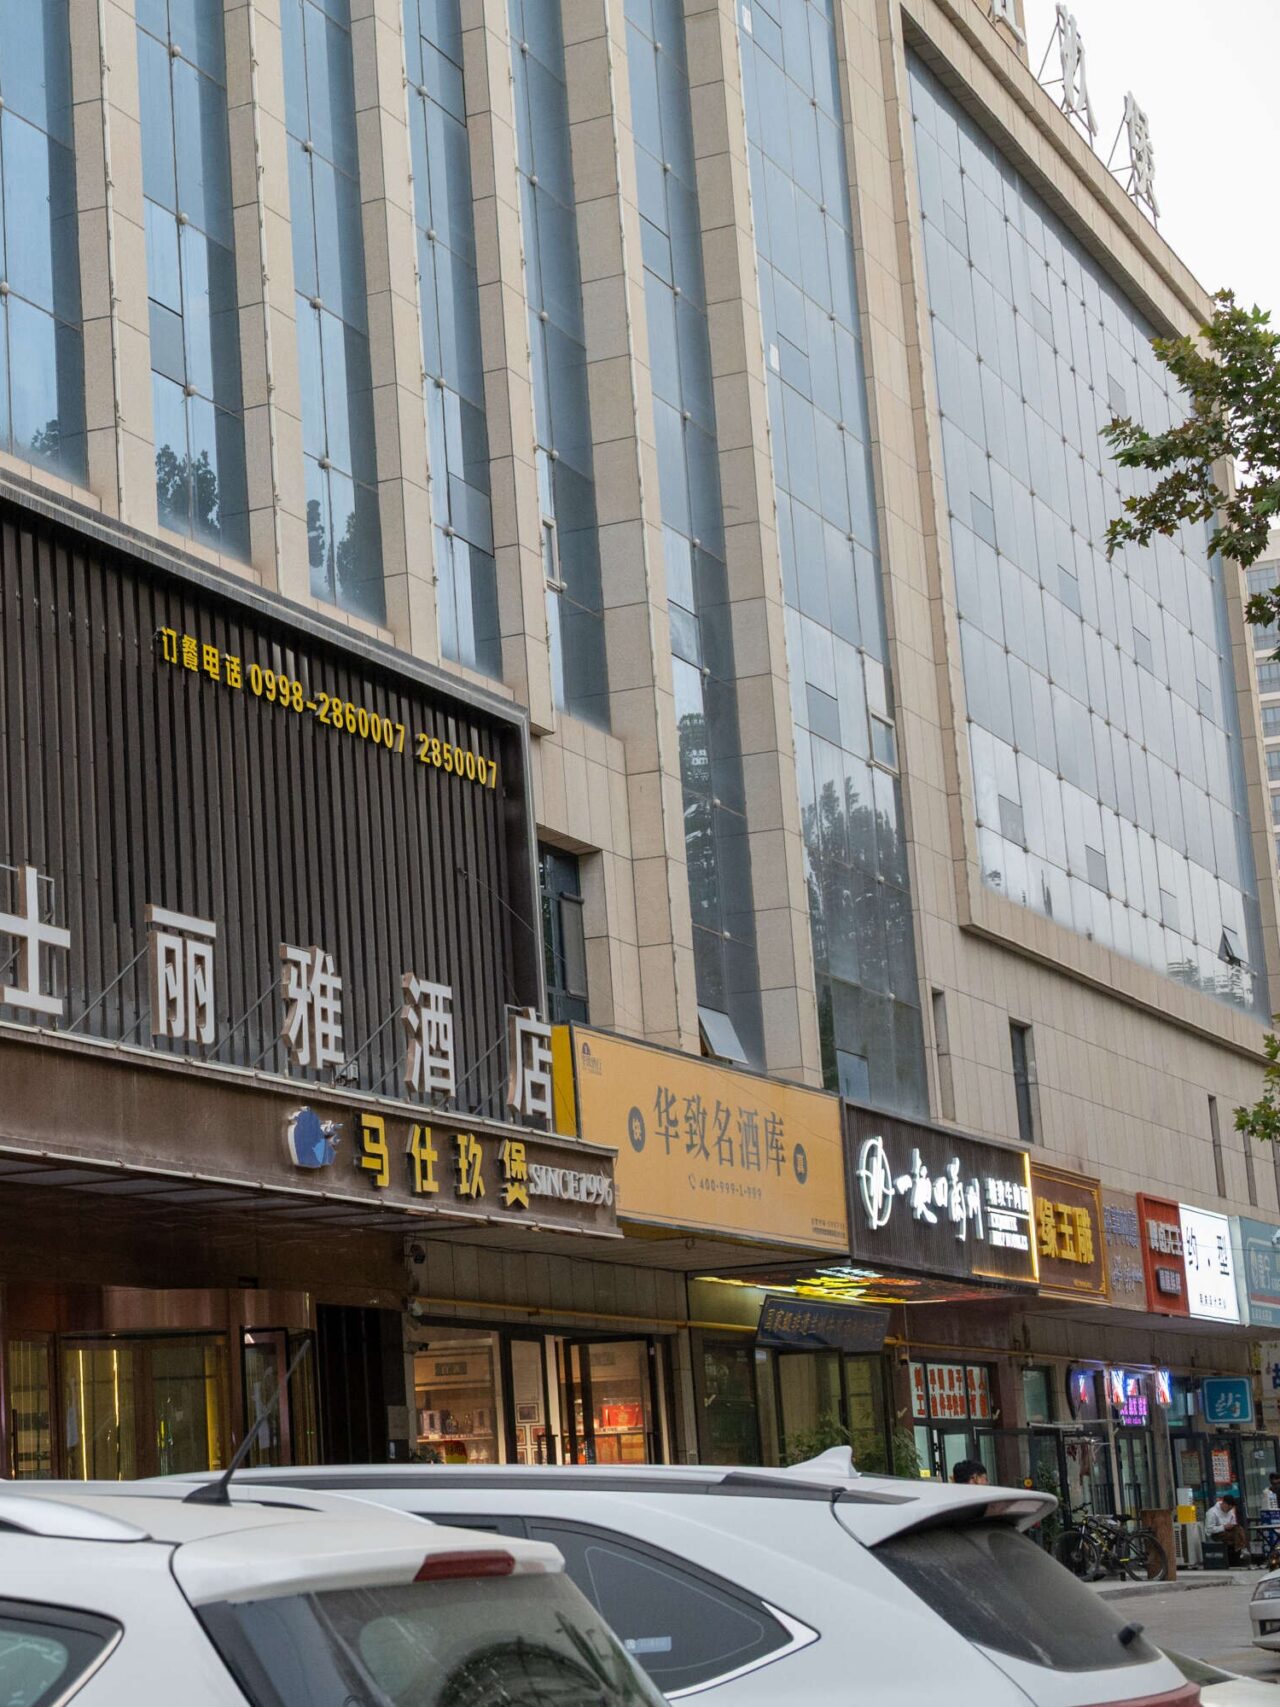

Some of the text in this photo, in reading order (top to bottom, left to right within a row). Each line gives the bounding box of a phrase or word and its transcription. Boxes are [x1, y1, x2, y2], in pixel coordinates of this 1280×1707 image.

[162, 626, 497, 790] 订餐电话 0998-2860007 2850007
[653, 1085, 787, 1177] 华致名酒库
